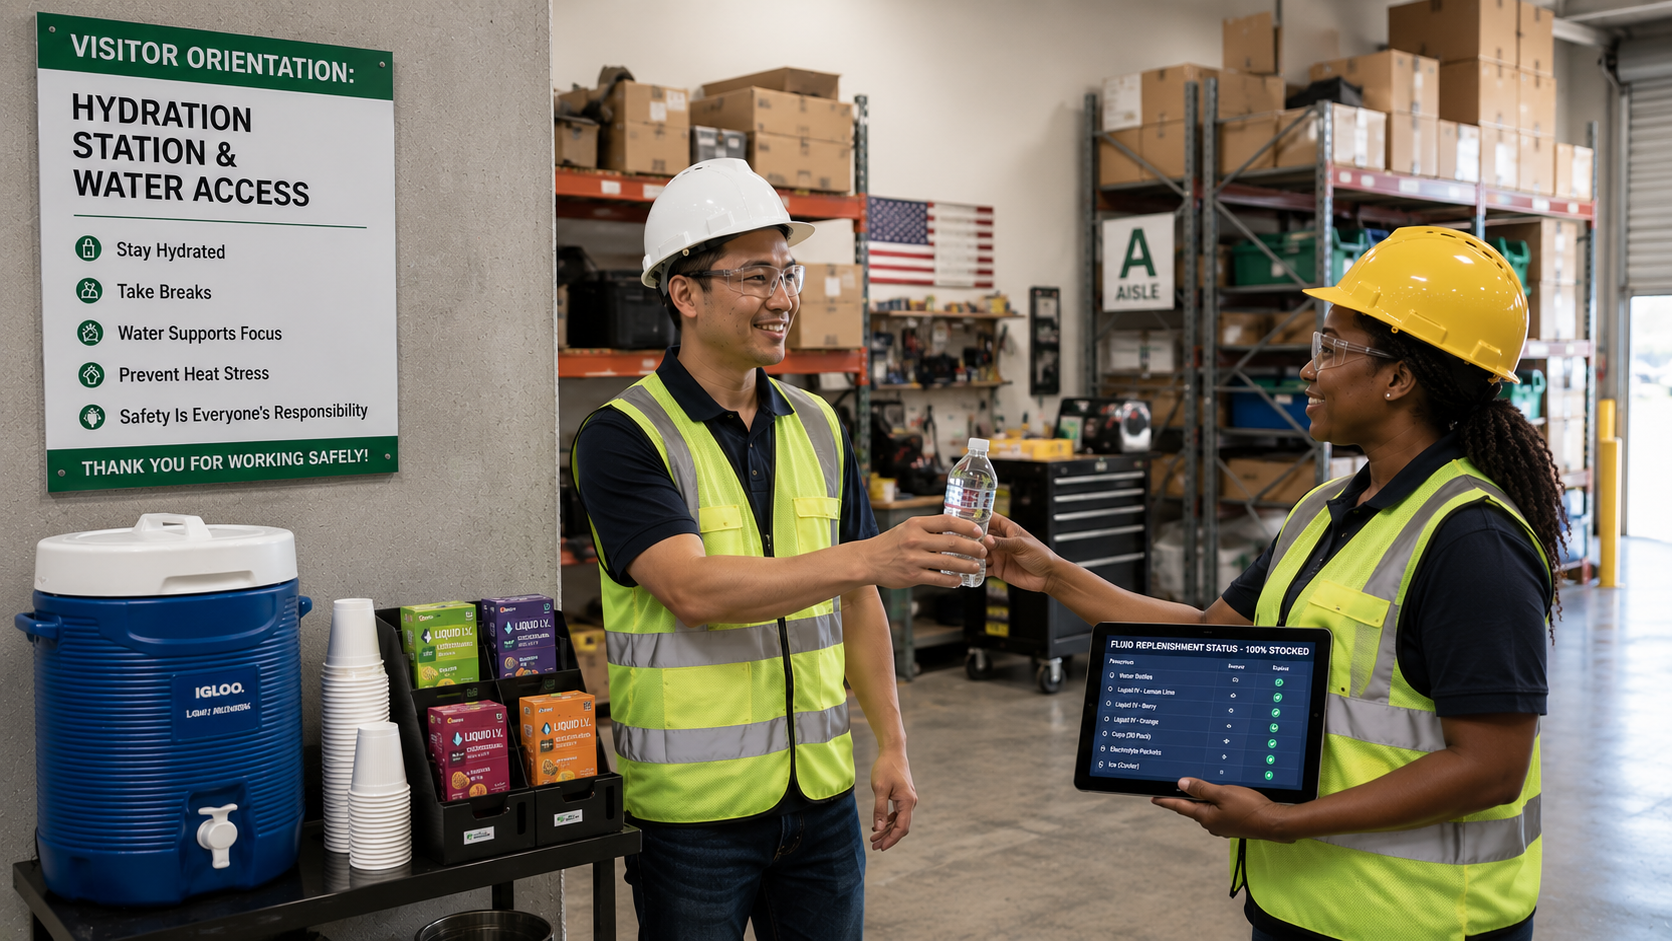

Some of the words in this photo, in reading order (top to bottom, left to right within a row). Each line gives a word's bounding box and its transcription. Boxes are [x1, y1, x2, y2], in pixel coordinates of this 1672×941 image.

[70, 33, 179, 67] VISITOR
[187, 46, 356, 84] ORIENTATION:
[72, 93, 252, 133] HYDRATION
[72, 132, 206, 166] STATION
[215, 141, 238, 168] &
[72, 169, 184, 201] WATER
[192, 176, 310, 207] ACCESS
[116, 241, 152, 262] Stay
[156, 242, 226, 262] Hydrated
[1119, 227, 1157, 279] A
[116, 283, 155, 299] Take
[159, 283, 212, 300] Breaks
[1115, 283, 1160, 301] AISLE
[117, 325, 165, 341] Water
[168, 325, 237, 345] Supports
[240, 325, 283, 341] Focus
[119, 367, 180, 383] Prevent
[184, 366, 220, 382] Heat
[224, 365, 270, 381] Stress
[120, 407, 171, 427] Safety
[175, 407, 188, 423] Is
[192, 405, 270, 425] Everyone's
[274, 402, 368, 423] Responsibility
[81, 458, 145, 477] THANK
[149, 456, 185, 473] YOU
[190, 455, 223, 471] FOR
[227, 451, 304, 469] WORKING
[308, 448, 368, 465] SAFELY!
[1135, 641, 1205, 652] REPLENISHMENT
[1205, 643, 1238, 653] STATUS
[1245, 645, 1268, 654] 100%
[1268, 646, 1310, 656] STOCKED
[195, 682, 245, 699] IGLOO.
